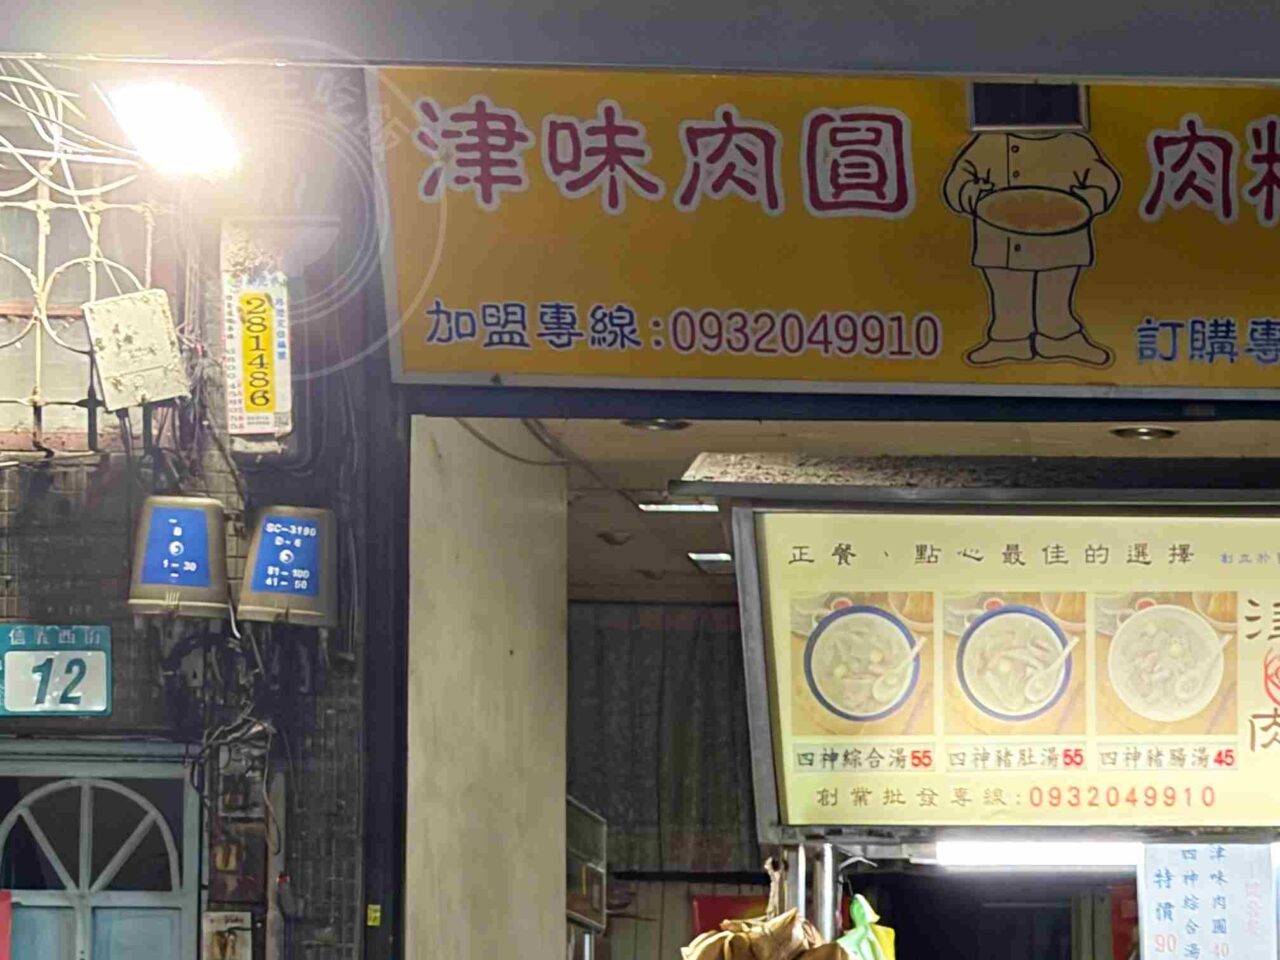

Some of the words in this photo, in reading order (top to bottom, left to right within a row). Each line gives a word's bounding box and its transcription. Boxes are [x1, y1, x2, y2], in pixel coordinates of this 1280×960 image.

[416, 98, 911, 216] 津味肉圓
[244, 296, 271, 407] 281486
[425, 300, 941, 357] 加盟專線:0932049910
[788, 542, 1196, 567] 正餐、點心最佳的選擇
[32, 657, 87, 705] 12
